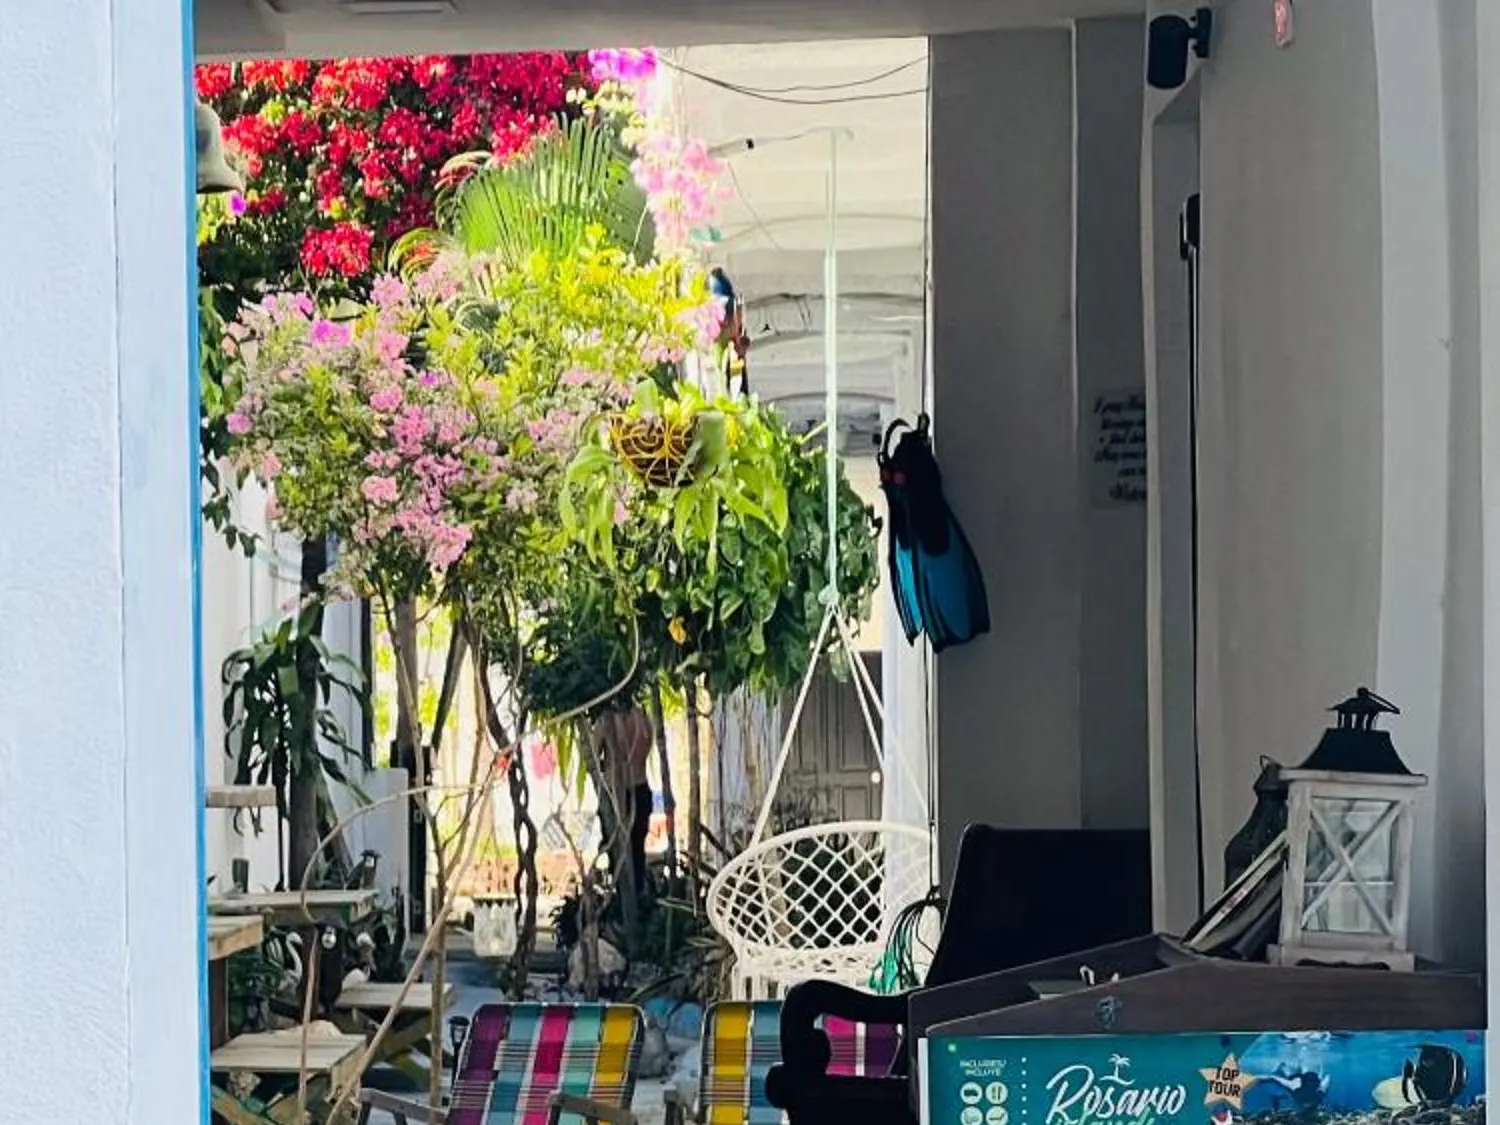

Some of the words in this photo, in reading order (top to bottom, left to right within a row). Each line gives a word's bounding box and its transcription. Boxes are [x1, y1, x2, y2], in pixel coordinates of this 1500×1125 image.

[1215, 1067, 1240, 1081] TOP
[1045, 1065, 1187, 1125] Rosario
[1208, 1080, 1241, 1097] TOUR
